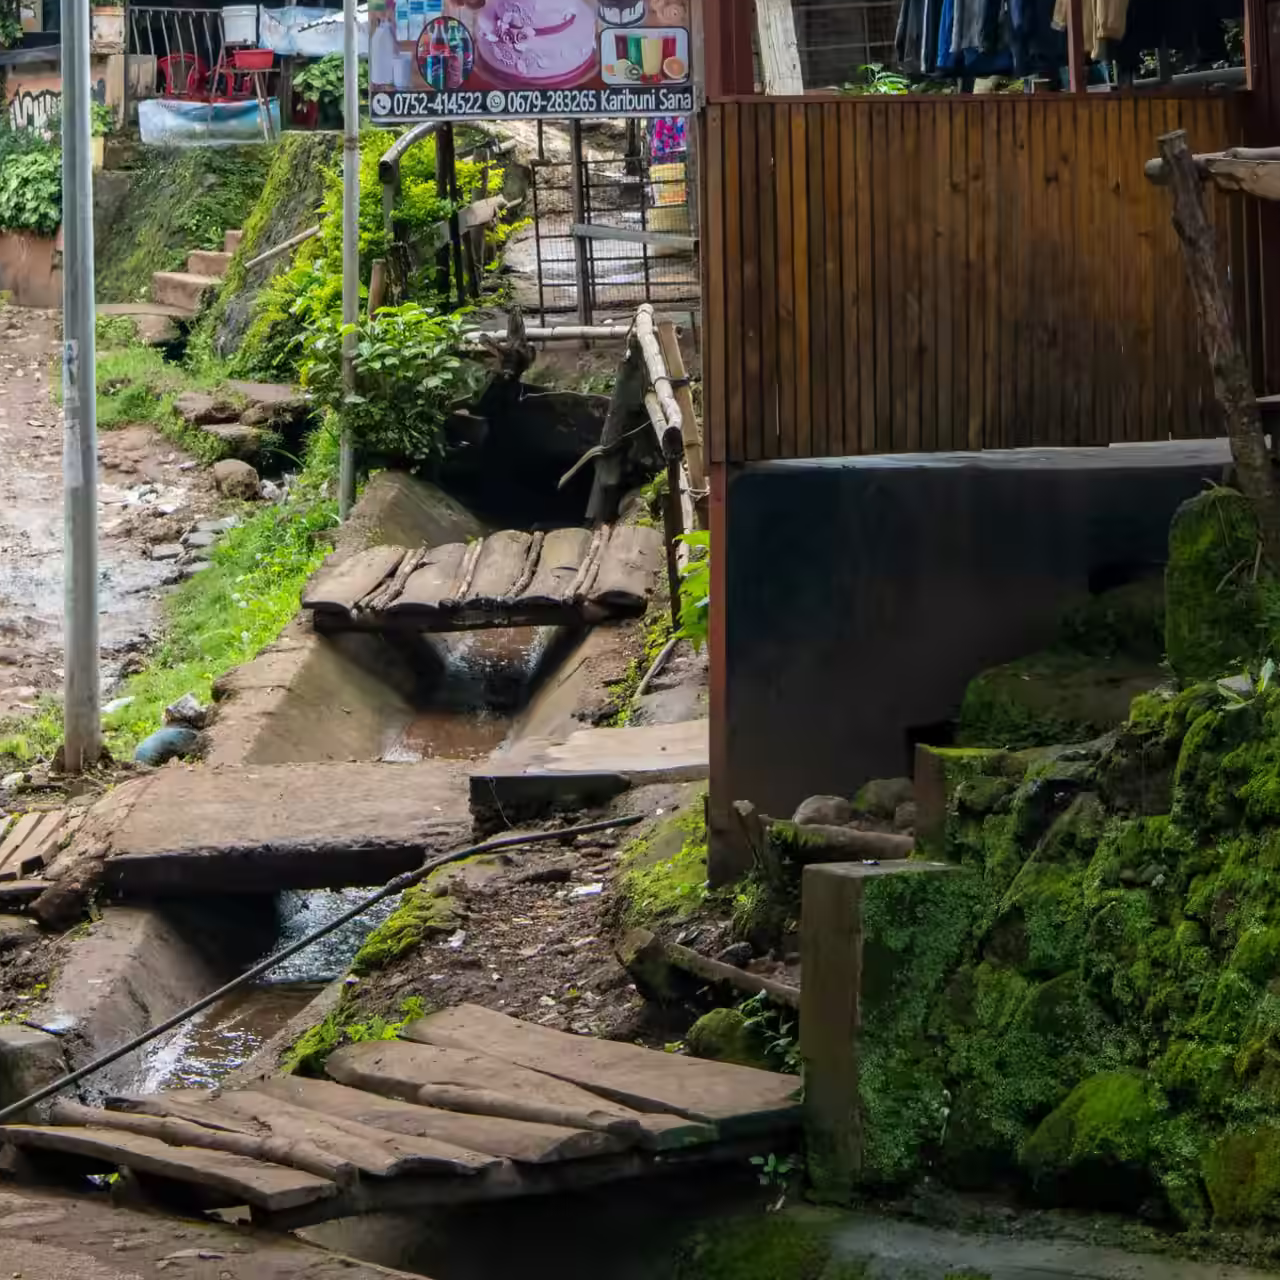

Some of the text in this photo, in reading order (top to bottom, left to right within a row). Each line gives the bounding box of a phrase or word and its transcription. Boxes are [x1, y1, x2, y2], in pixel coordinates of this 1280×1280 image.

[393, 89, 692, 114] 0752-414522 0679-283265 Karibuni Sana
